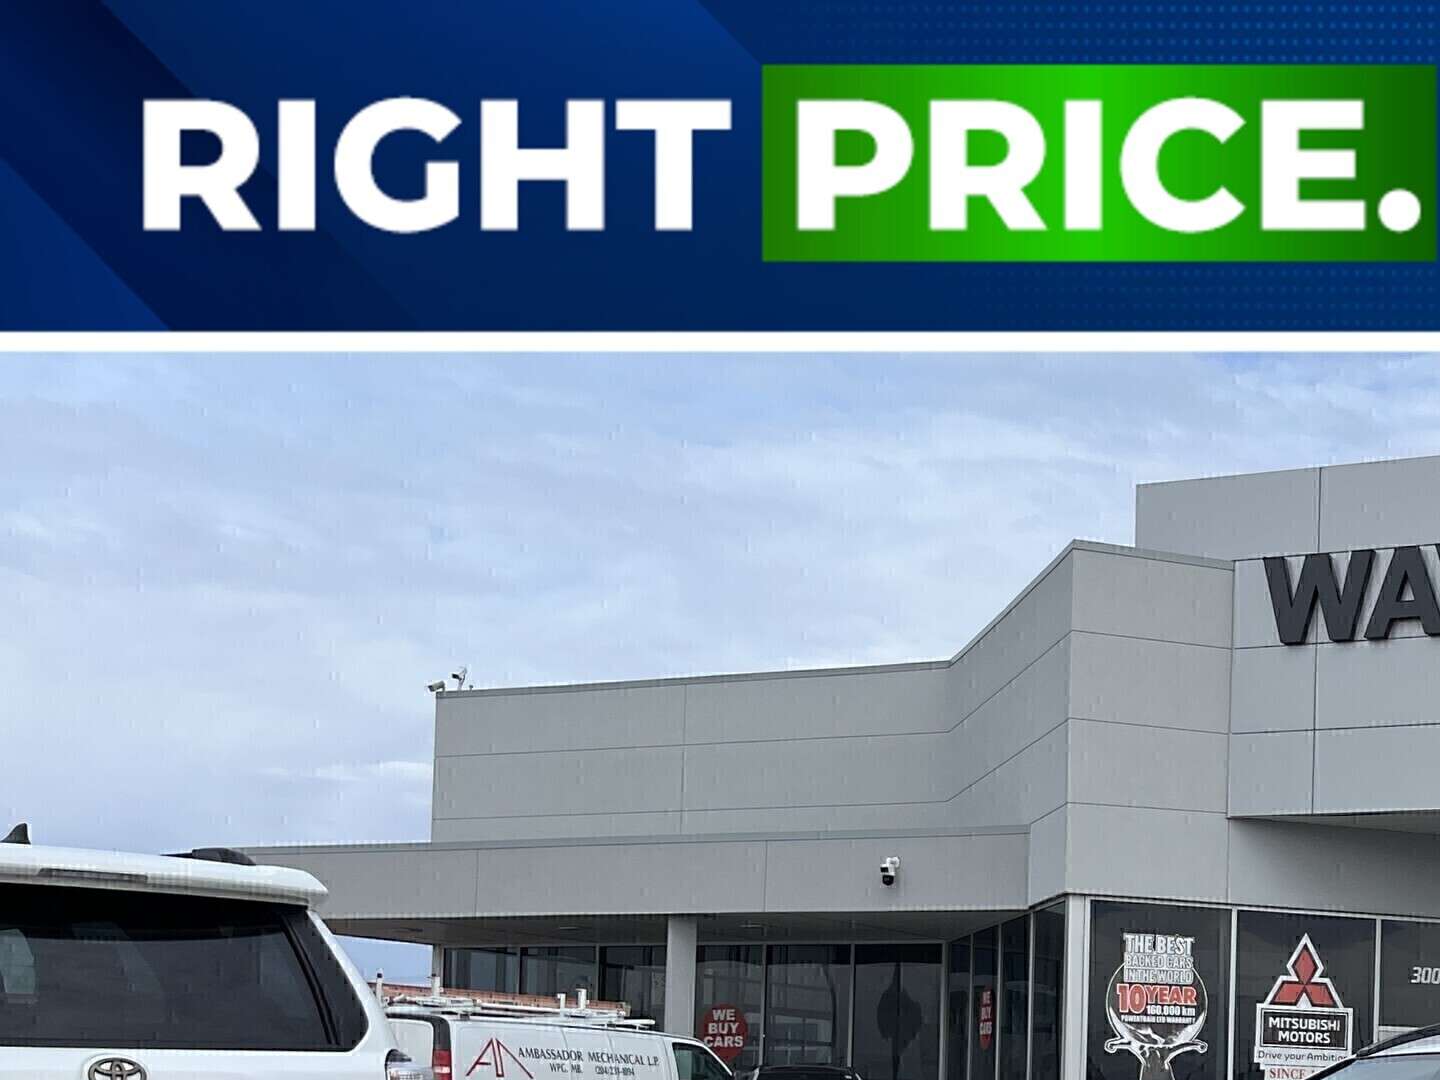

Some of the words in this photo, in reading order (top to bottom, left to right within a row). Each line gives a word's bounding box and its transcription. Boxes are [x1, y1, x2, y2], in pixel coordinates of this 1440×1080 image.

[1123, 933, 1154, 954] THE
[1156, 934, 1195, 956] BEST
[1124, 953, 1165, 968] BACKED
[1166, 955, 1194, 969] CARS
[1157, 969, 1194, 984] WORLD
[1117, 983, 1146, 1014] 10
[1145, 985, 1197, 1006] YEAR
[712, 1009, 736, 1020] WE
[1182, 1007, 1195, 1016] km
[708, 1022, 740, 1034] BUY
[1268, 1017, 1340, 1031] MITSUBISHI
[704, 1036, 744, 1047] CARS
[1278, 1031, 1331, 1044] MOTORS
[518, 1047, 584, 1062] AMBASSADOR
[588, 1052, 644, 1066] MECHANICAL
[1258, 1050, 1282, 1059] Drive
[1284, 1053, 1305, 1062] your
